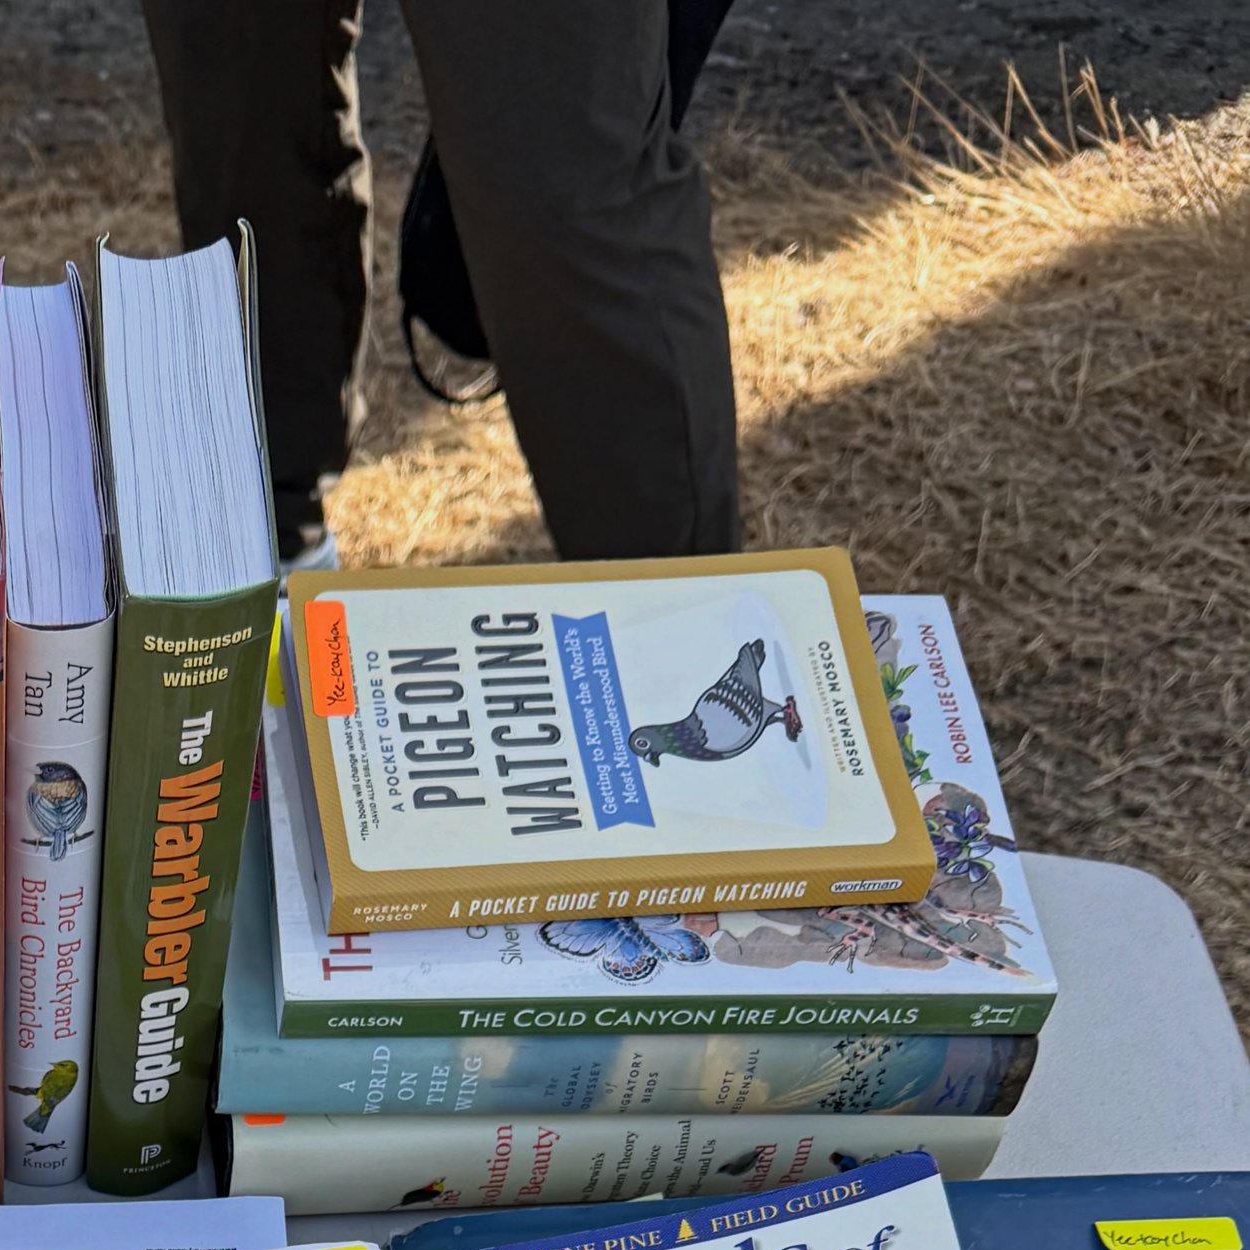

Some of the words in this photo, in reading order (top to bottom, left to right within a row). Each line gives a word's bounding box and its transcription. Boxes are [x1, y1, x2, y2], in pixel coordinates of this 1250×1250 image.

[143, 626, 252, 656] Stephenson
[183, 653, 213, 668] and
[366, 651, 380, 673] TO
[564, 627, 586, 681] World's
[587, 635, 607, 667] Bird
[163, 667, 228, 688] Whittle
[820, 641, 842, 693] MOSCO
[24, 671, 52, 718] Tan
[58, 662, 93, 724] Amy
[370, 677, 390, 727] GUIDE
[576, 681, 592, 705] the
[179, 710, 212, 766] The
[388, 647, 486, 810] PIGEON
[470, 612, 582, 836] WATCHING
[584, 708, 601, 746] Know
[594, 668, 630, 768] Misunderstood
[833, 697, 864, 776] ROSEMARY
[380, 735, 401, 797] POCKET
[592, 747, 605, 762] to
[392, 803, 405, 812] A
[597, 763, 617, 815] Getting
[620, 771, 638, 803] Most
[142, 760, 224, 985] Warbler
[832, 880, 900, 892] workman
[20, 877, 46, 925] Bird
[59, 887, 84, 934] The
[18, 934, 45, 1050] Chronicles
[50, 938, 82, 1040] Backyard
[328, 1016, 403, 1027] CARLSON
[458, 1010, 506, 1028] THE
[513, 1009, 587, 1027] COLD
[594, 1008, 716, 1026] CANYON
[722, 1007, 777, 1024] FIRE
[779, 1007, 919, 1025] JOURNALS
[132, 986, 189, 1104] Guide
[338, 1080, 355, 1091] A
[363, 1045, 390, 1114] WORLD
[398, 1071, 418, 1101] ON
[426, 1065, 450, 1105] THE
[455, 1056, 482, 1111] WING
[518, 1127, 561, 1198] Beauty
[711, 1204, 778, 1234] FIELD
[785, 1179, 866, 1213] GUIDE
